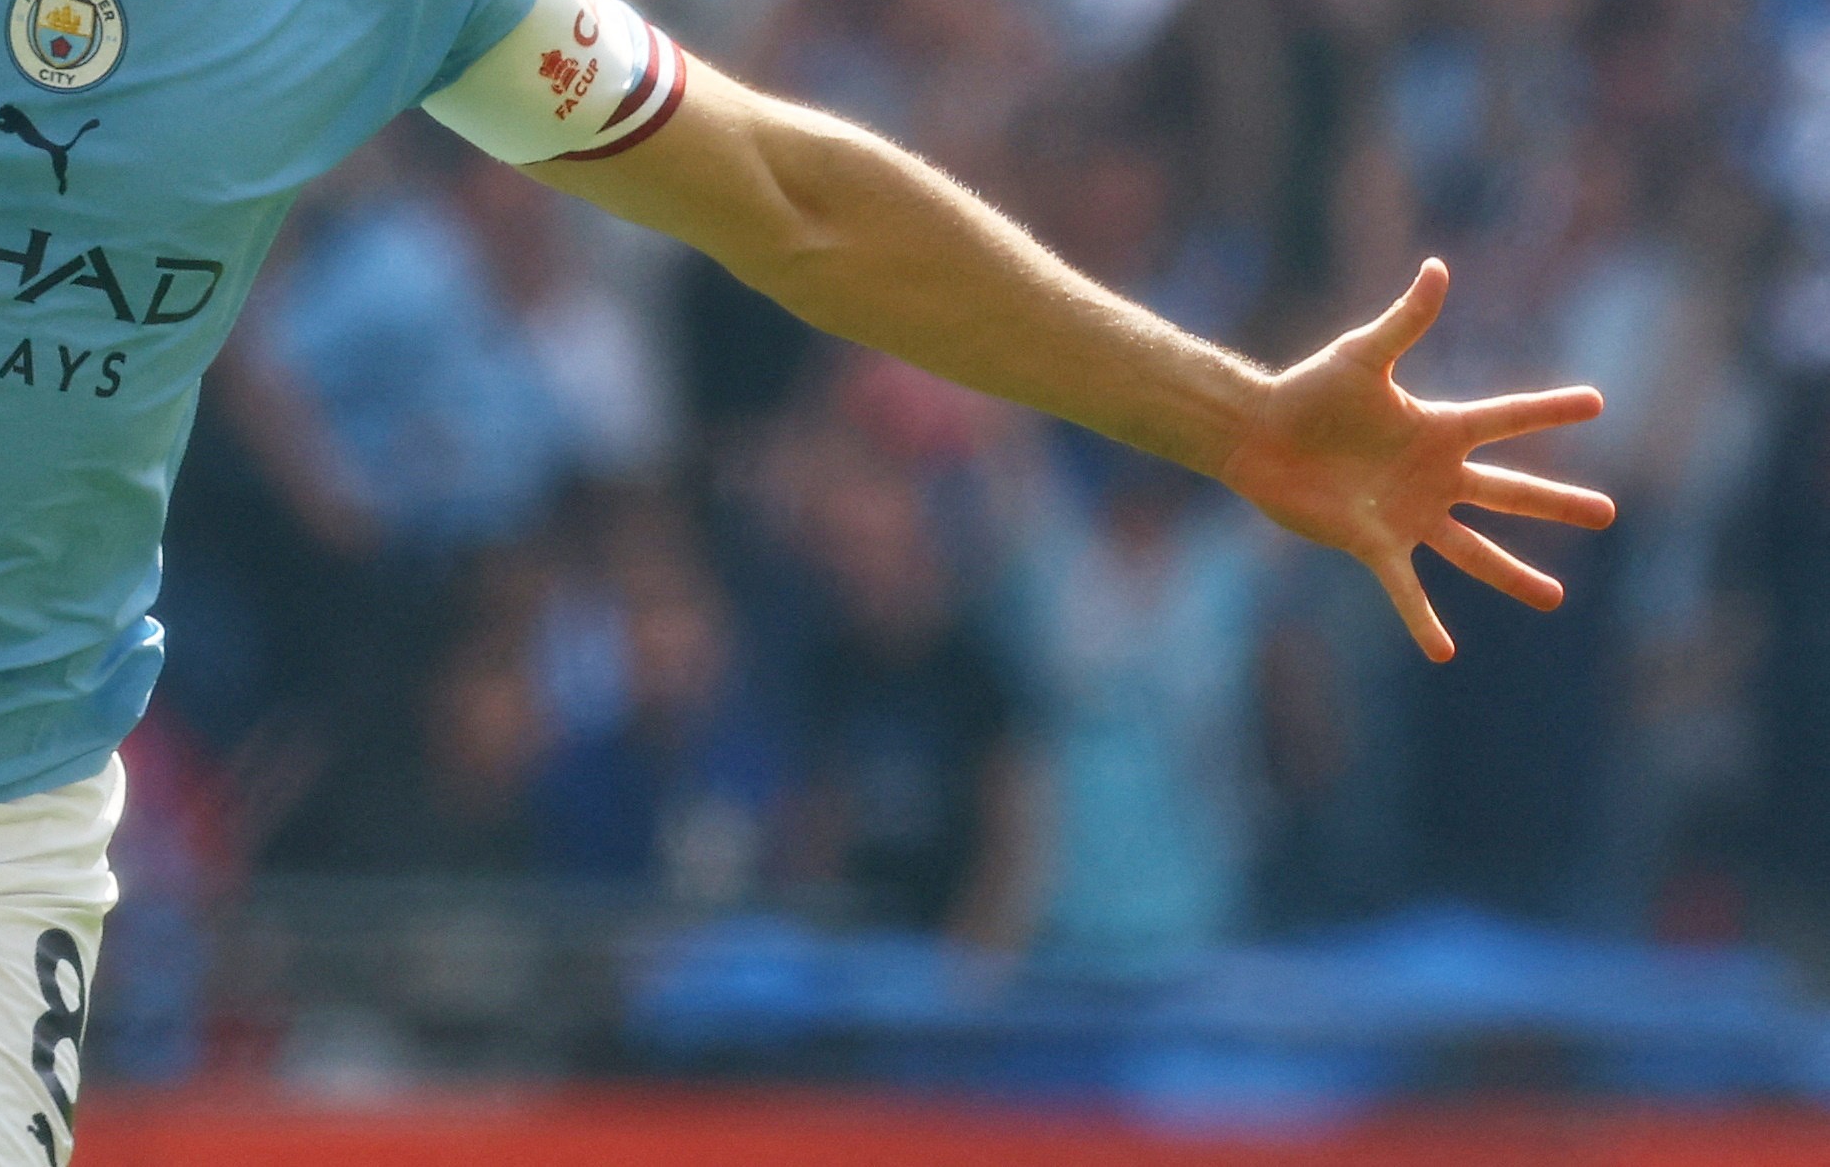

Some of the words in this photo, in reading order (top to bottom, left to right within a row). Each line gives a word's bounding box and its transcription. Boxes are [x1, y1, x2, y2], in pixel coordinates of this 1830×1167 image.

[39, 69, 77, 84] CITY
[554, 97, 579, 121] FA
[574, 58, 600, 97] CUP
[32, 927, 85, 1133] 8
